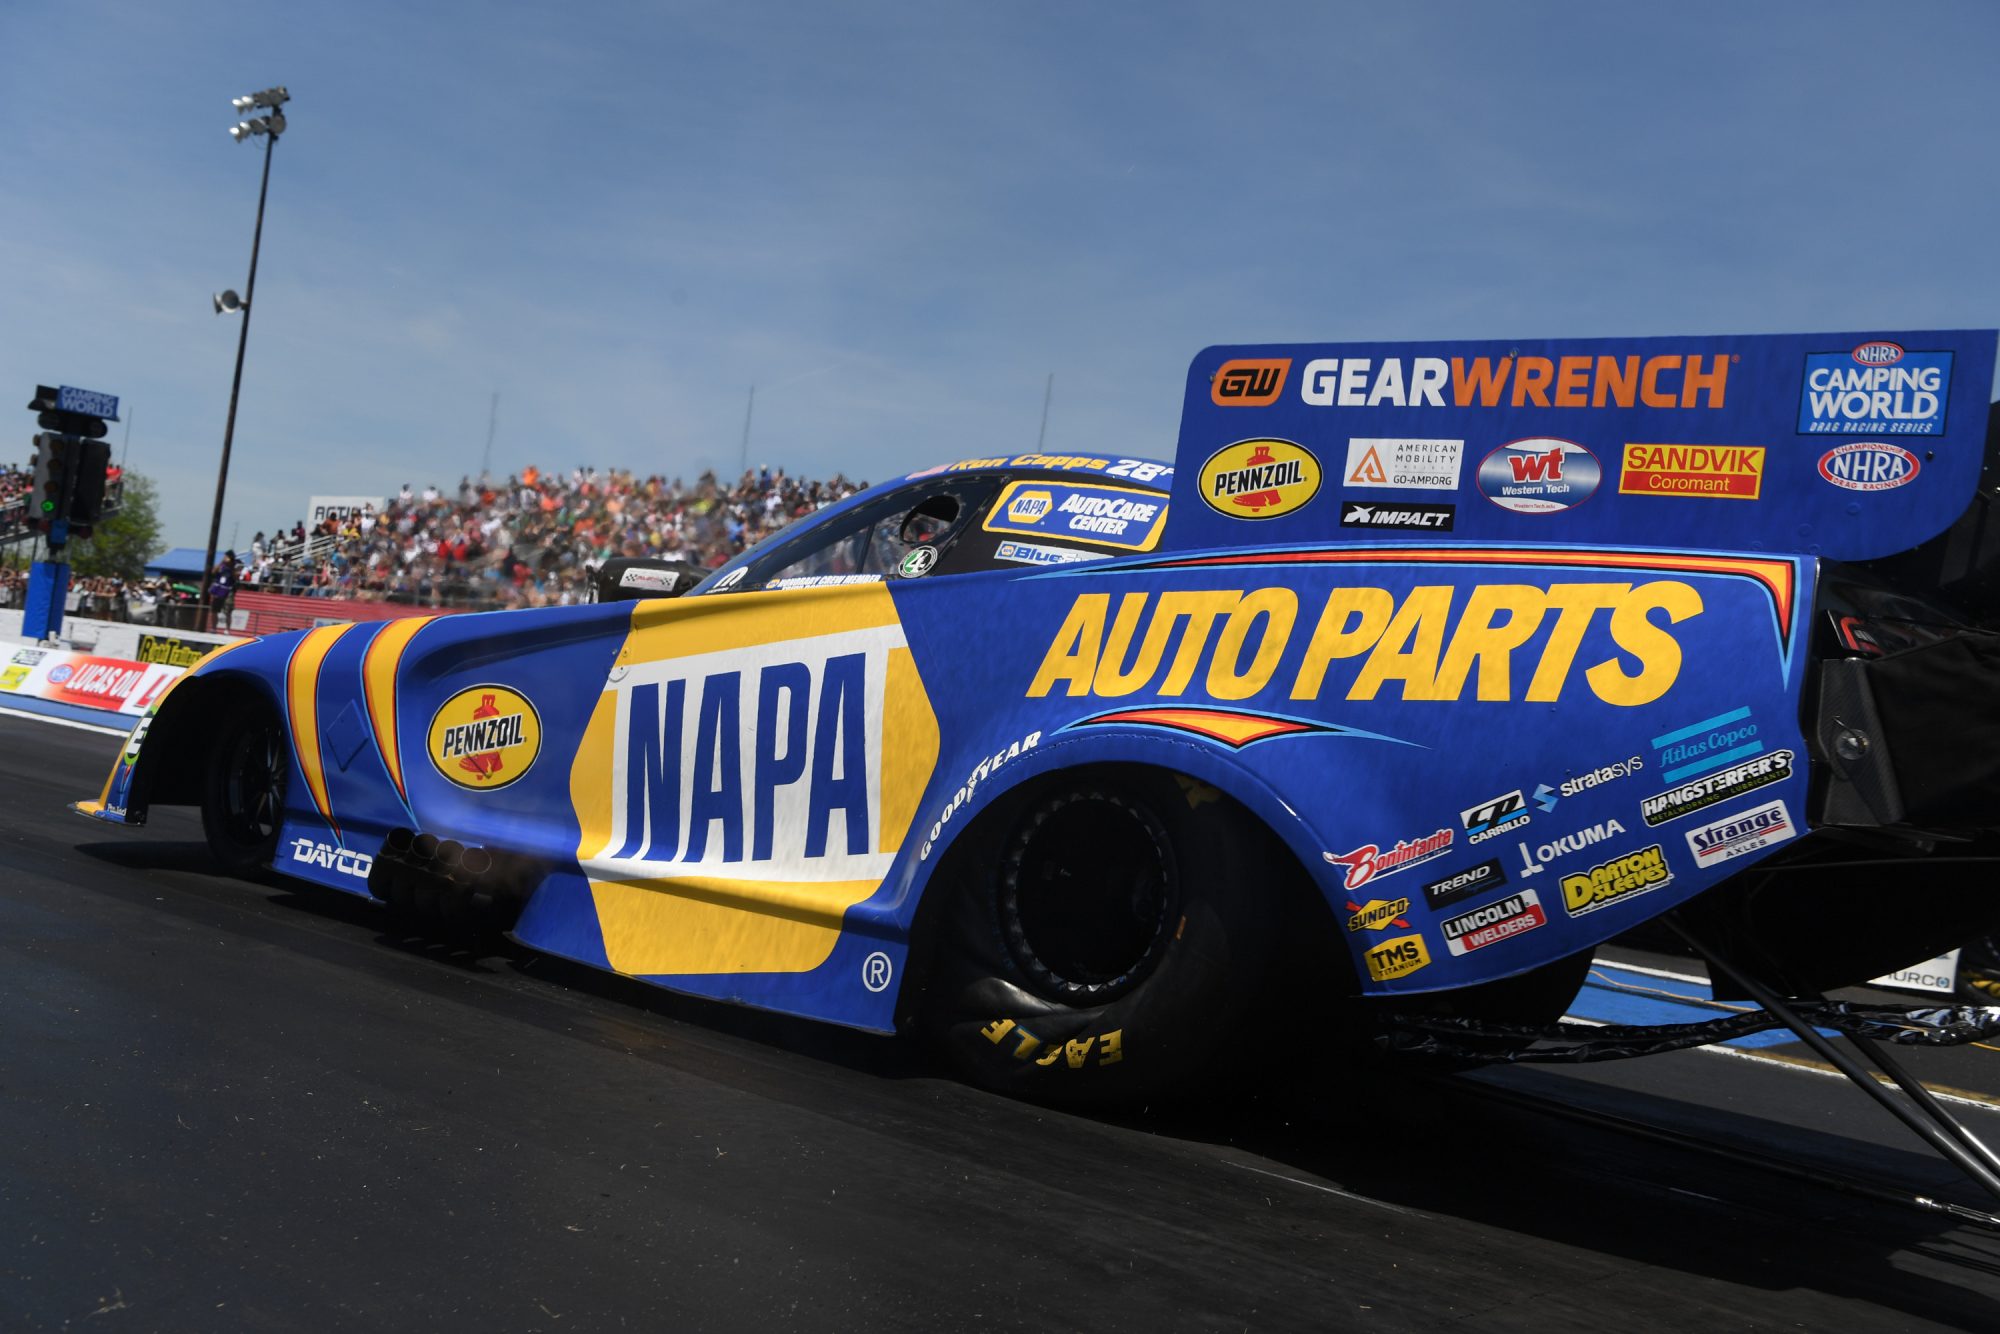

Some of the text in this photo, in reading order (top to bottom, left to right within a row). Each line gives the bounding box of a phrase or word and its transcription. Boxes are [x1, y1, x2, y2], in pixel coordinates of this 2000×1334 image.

[1860, 347, 1896, 362] NHRA
[1219, 368, 1280, 397] GW
[1301, 356, 1729, 408] GEARWRENCH
[1809, 367, 1942, 391] CAMPING
[61, 398, 114, 417] WORLD
[62, 387, 116, 407] CAMPING
[1809, 391, 1939, 420] WORLD
[1809, 421, 1933, 433] DRAG RACING SERIES
[949, 457, 1007, 471] Ron
[1009, 454, 1109, 470] Capps
[1395, 454, 1455, 463] MOBILITY
[1397, 444, 1457, 453] AMERICAN
[1627, 446, 1760, 473] SANDVIK
[1835, 443, 1905, 454] CHAMPIONSHIP
[1214, 460, 1303, 497] PENNZOIL
[1393, 475, 1452, 486] GO-AMP.ORG
[1833, 452, 1905, 481] NHRA
[1502, 484, 1570, 495] Western Tech
[1648, 474, 1730, 492] Coromant
[1832, 477, 1900, 490] DRAG RACING
[1013, 499, 1047, 515] NAPA
[1068, 515, 1129, 535] CENTER
[1026, 581, 1704, 706] AUTO PARTS
[65, 664, 122, 694] LUCAS
[109, 670, 144, 699] OIL
[443, 714, 525, 757] PENNZOIL
[1659, 724, 1758, 768] Atlas Copco
[611, 652, 869, 864] NAPA
[1559, 755, 1644, 798] stratasys
[1644, 752, 1788, 817] HANGSTERFER'S
[920, 731, 1042, 861] GOODYEAR
[1650, 769, 1788, 822] METALWORKING LUBRICANTS
[1469, 815, 1531, 845] CARRILLO
[1693, 809, 1783, 852] Strange
[290, 837, 374, 879] DAYCO
[1725, 838, 1768, 858] AXLES
[1430, 865, 1490, 895] TREND
[1562, 847, 1661, 911] DARTON
[1592, 862, 1667, 901] SLEEVES
[1350, 899, 1407, 931] SUNOCO
[1446, 898, 1522, 938] LINCOLN
[1468, 913, 1537, 948] WELDERS
[1372, 941, 1420, 970] TMS
[1378, 957, 1423, 978] TITANIUM
